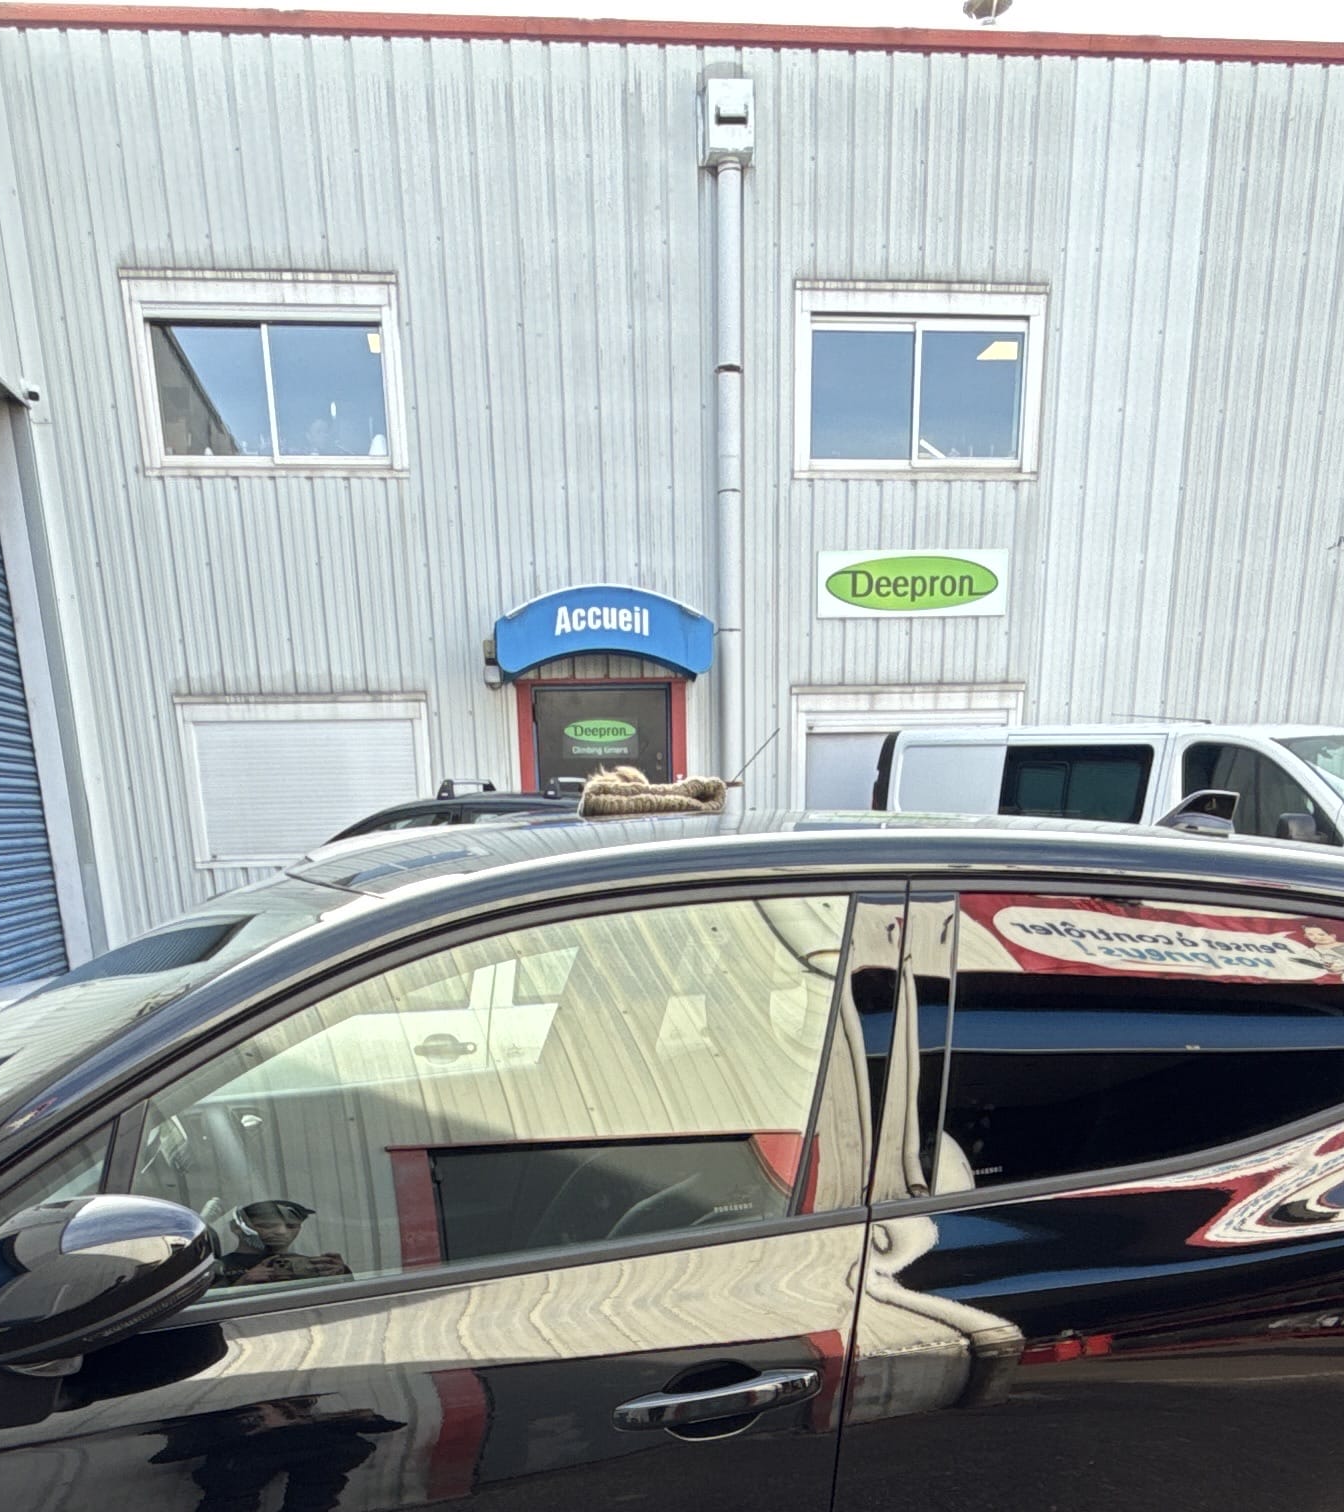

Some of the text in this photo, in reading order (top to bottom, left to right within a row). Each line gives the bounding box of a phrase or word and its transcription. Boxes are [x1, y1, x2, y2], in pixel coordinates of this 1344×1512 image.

[849, 569, 977, 602] Deepron
[554, 606, 650, 637] Accueil
[572, 725, 628, 739] Deepron
